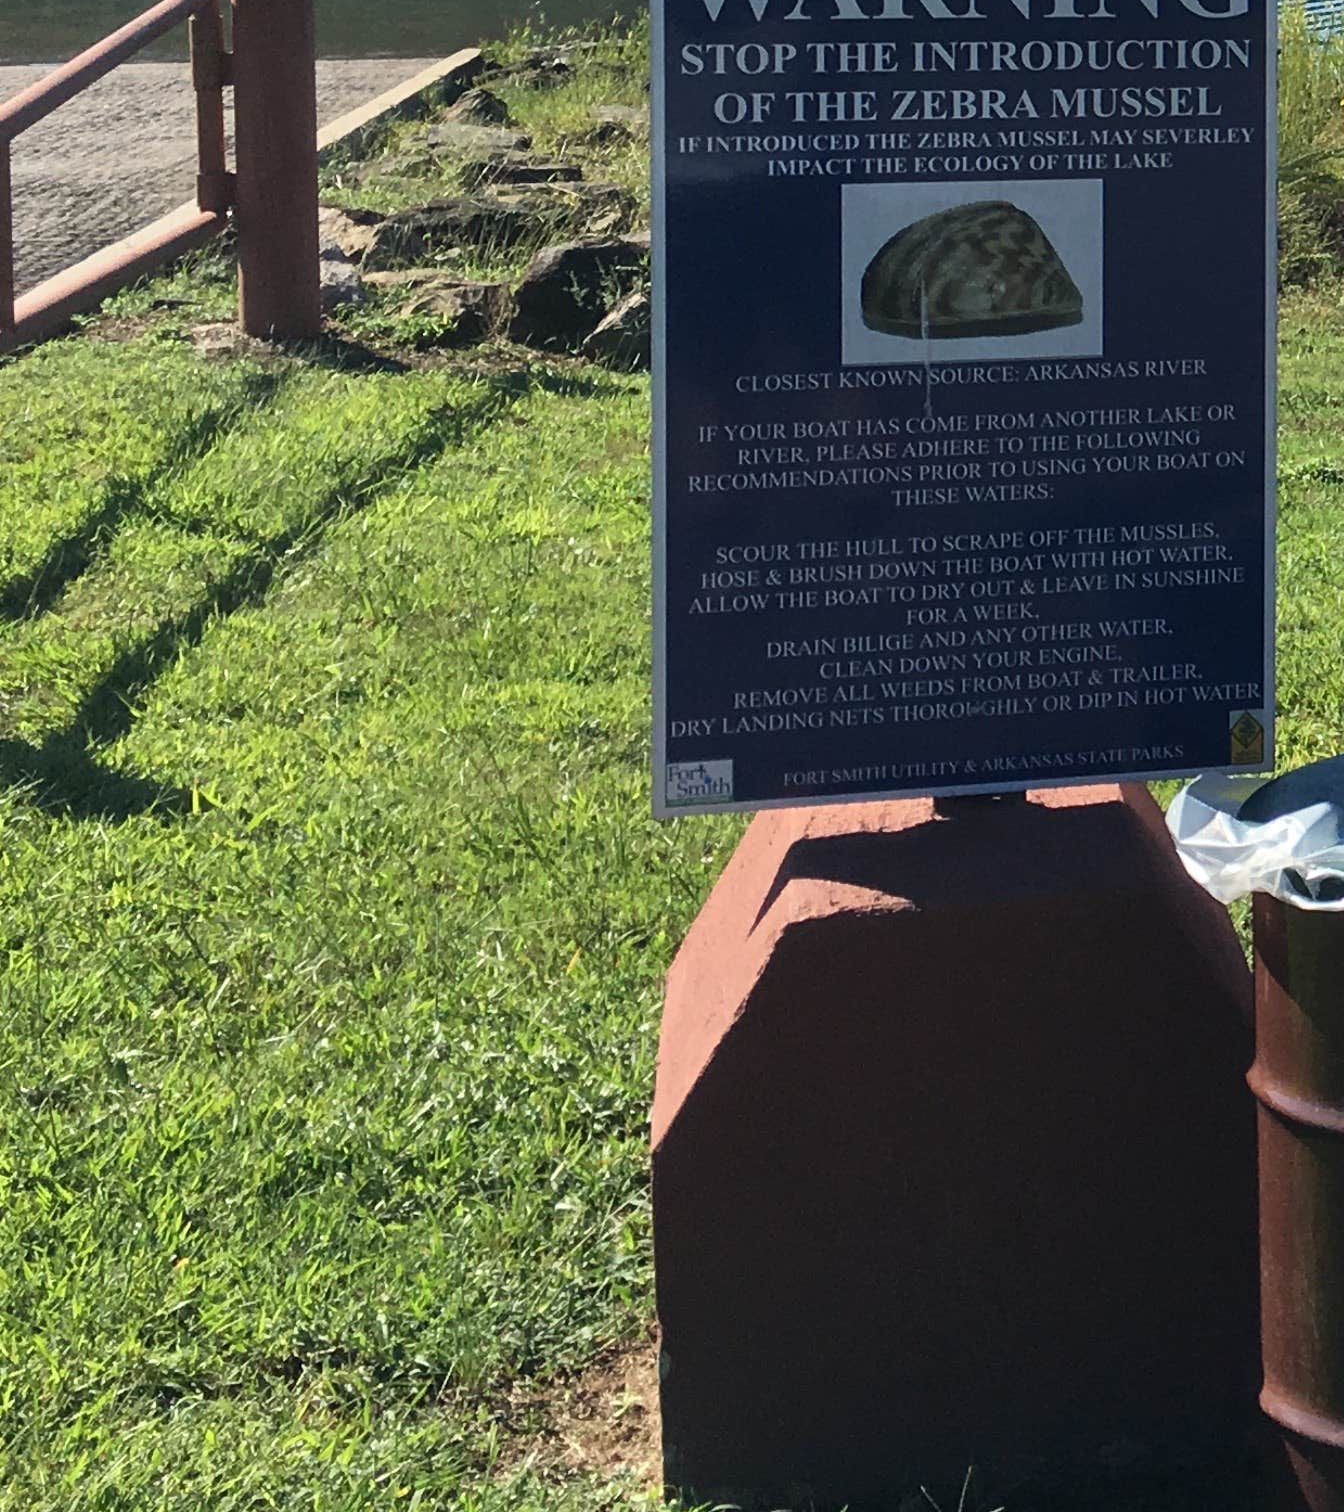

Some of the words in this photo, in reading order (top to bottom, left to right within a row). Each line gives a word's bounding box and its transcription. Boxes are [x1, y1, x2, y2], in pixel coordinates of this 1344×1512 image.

[681, 44, 796, 75] STOP
[806, 42, 898, 73] THE
[913, 39, 1250, 72] INTRODUCTION
[714, 93, 775, 124] OF
[785, 91, 878, 122] THE
[891, 89, 1040, 120] ZEBRA
[1050, 87, 1222, 118] MUSSEL
[680, 137, 701, 153] IF
[707, 135, 859, 152] INTRODUCED
[865, 133, 911, 149] THE
[918, 132, 992, 148] ZEBRA
[998, 130, 1085, 147] MUSSEL
[1090, 129, 1137, 145] MAY
[1143, 128, 1254, 144] SEVERLEY
[768, 158, 856, 176] IMPACT
[862, 157, 907, 173] THE
[915, 155, 1023, 173] ECOLOGY
[1029, 154, 1059, 170] OF
[1064, 154, 1107, 170] THE
[1114, 152, 1173, 168] LAKE
[736, 373, 832, 392] CLOSEST
[840, 370, 922, 388] KNOWN
[1025, 361, 1139, 381] ARKANSAS
[1145, 359, 1207, 376] RIVER
[700, 426, 718, 443] IF
[724, 424, 786, 441] YOUR
[794, 420, 850, 438] BOAT
[857, 419, 900, 436] HAS
[906, 416, 967, 434] COME
[975, 413, 1034, 431] FROM
[1041, 408, 1141, 427] ANOTHER
[1148, 406, 1201, 423] LAKE
[1207, 405, 1235, 421] OR
[817, 443, 895, 462] PLEASE
[902, 439, 989, 458] ADHERE
[999, 437, 1023, 454] TO
[1029, 435, 1069, 452] THE
[1076, 430, 1200, 450] FOLLOWING
[688, 466, 912, 492] RECOMMENDATIONS
[920, 463, 981, 481] PRIOR
[988, 461, 1016, 478] TO
[1022, 458, 1086, 476] USING
[1092, 455, 1150, 472] YOUR
[1157, 452, 1211, 470] BOAT
[1216, 451, 1245, 467] ON
[891, 488, 958, 506] THESE
[689, 594, 769, 614] ALLOW
[775, 591, 817, 609] THE
[825, 587, 882, 606] BOAT
[886, 586, 915, 602] TO
[922, 582, 964, 600] DRY
[970, 580, 1015, 598] OUT
[1020, 579, 1035, 595] &
[1043, 575, 1108, 593] LEAVE
[1115, 573, 1135, 590] IN
[1142, 567, 1243, 588] SUNSHINE
[671, 718, 716, 737] DRY
[723, 712, 823, 733] LANDING
[830, 707, 884, 726] NETS
[1043, 695, 1072, 712] OR
[1079, 693, 1112, 709] DIP
[1118, 691, 1137, 707] IN
[1145, 688, 1183, 705] HOT
[1192, 683, 1261, 701] WATER
[668, 765, 706, 782] Fort
[784, 770, 825, 786] FORT
[832, 765, 886, 783] SMITH
[892, 761, 958, 778] UTILITY
[964, 760, 977, 773] &
[981, 753, 1074, 771] ARKANSAS
[1078, 748, 1127, 764] STATE
[1132, 745, 1184, 761] PARKS
[677, 777, 731, 798] Smith
